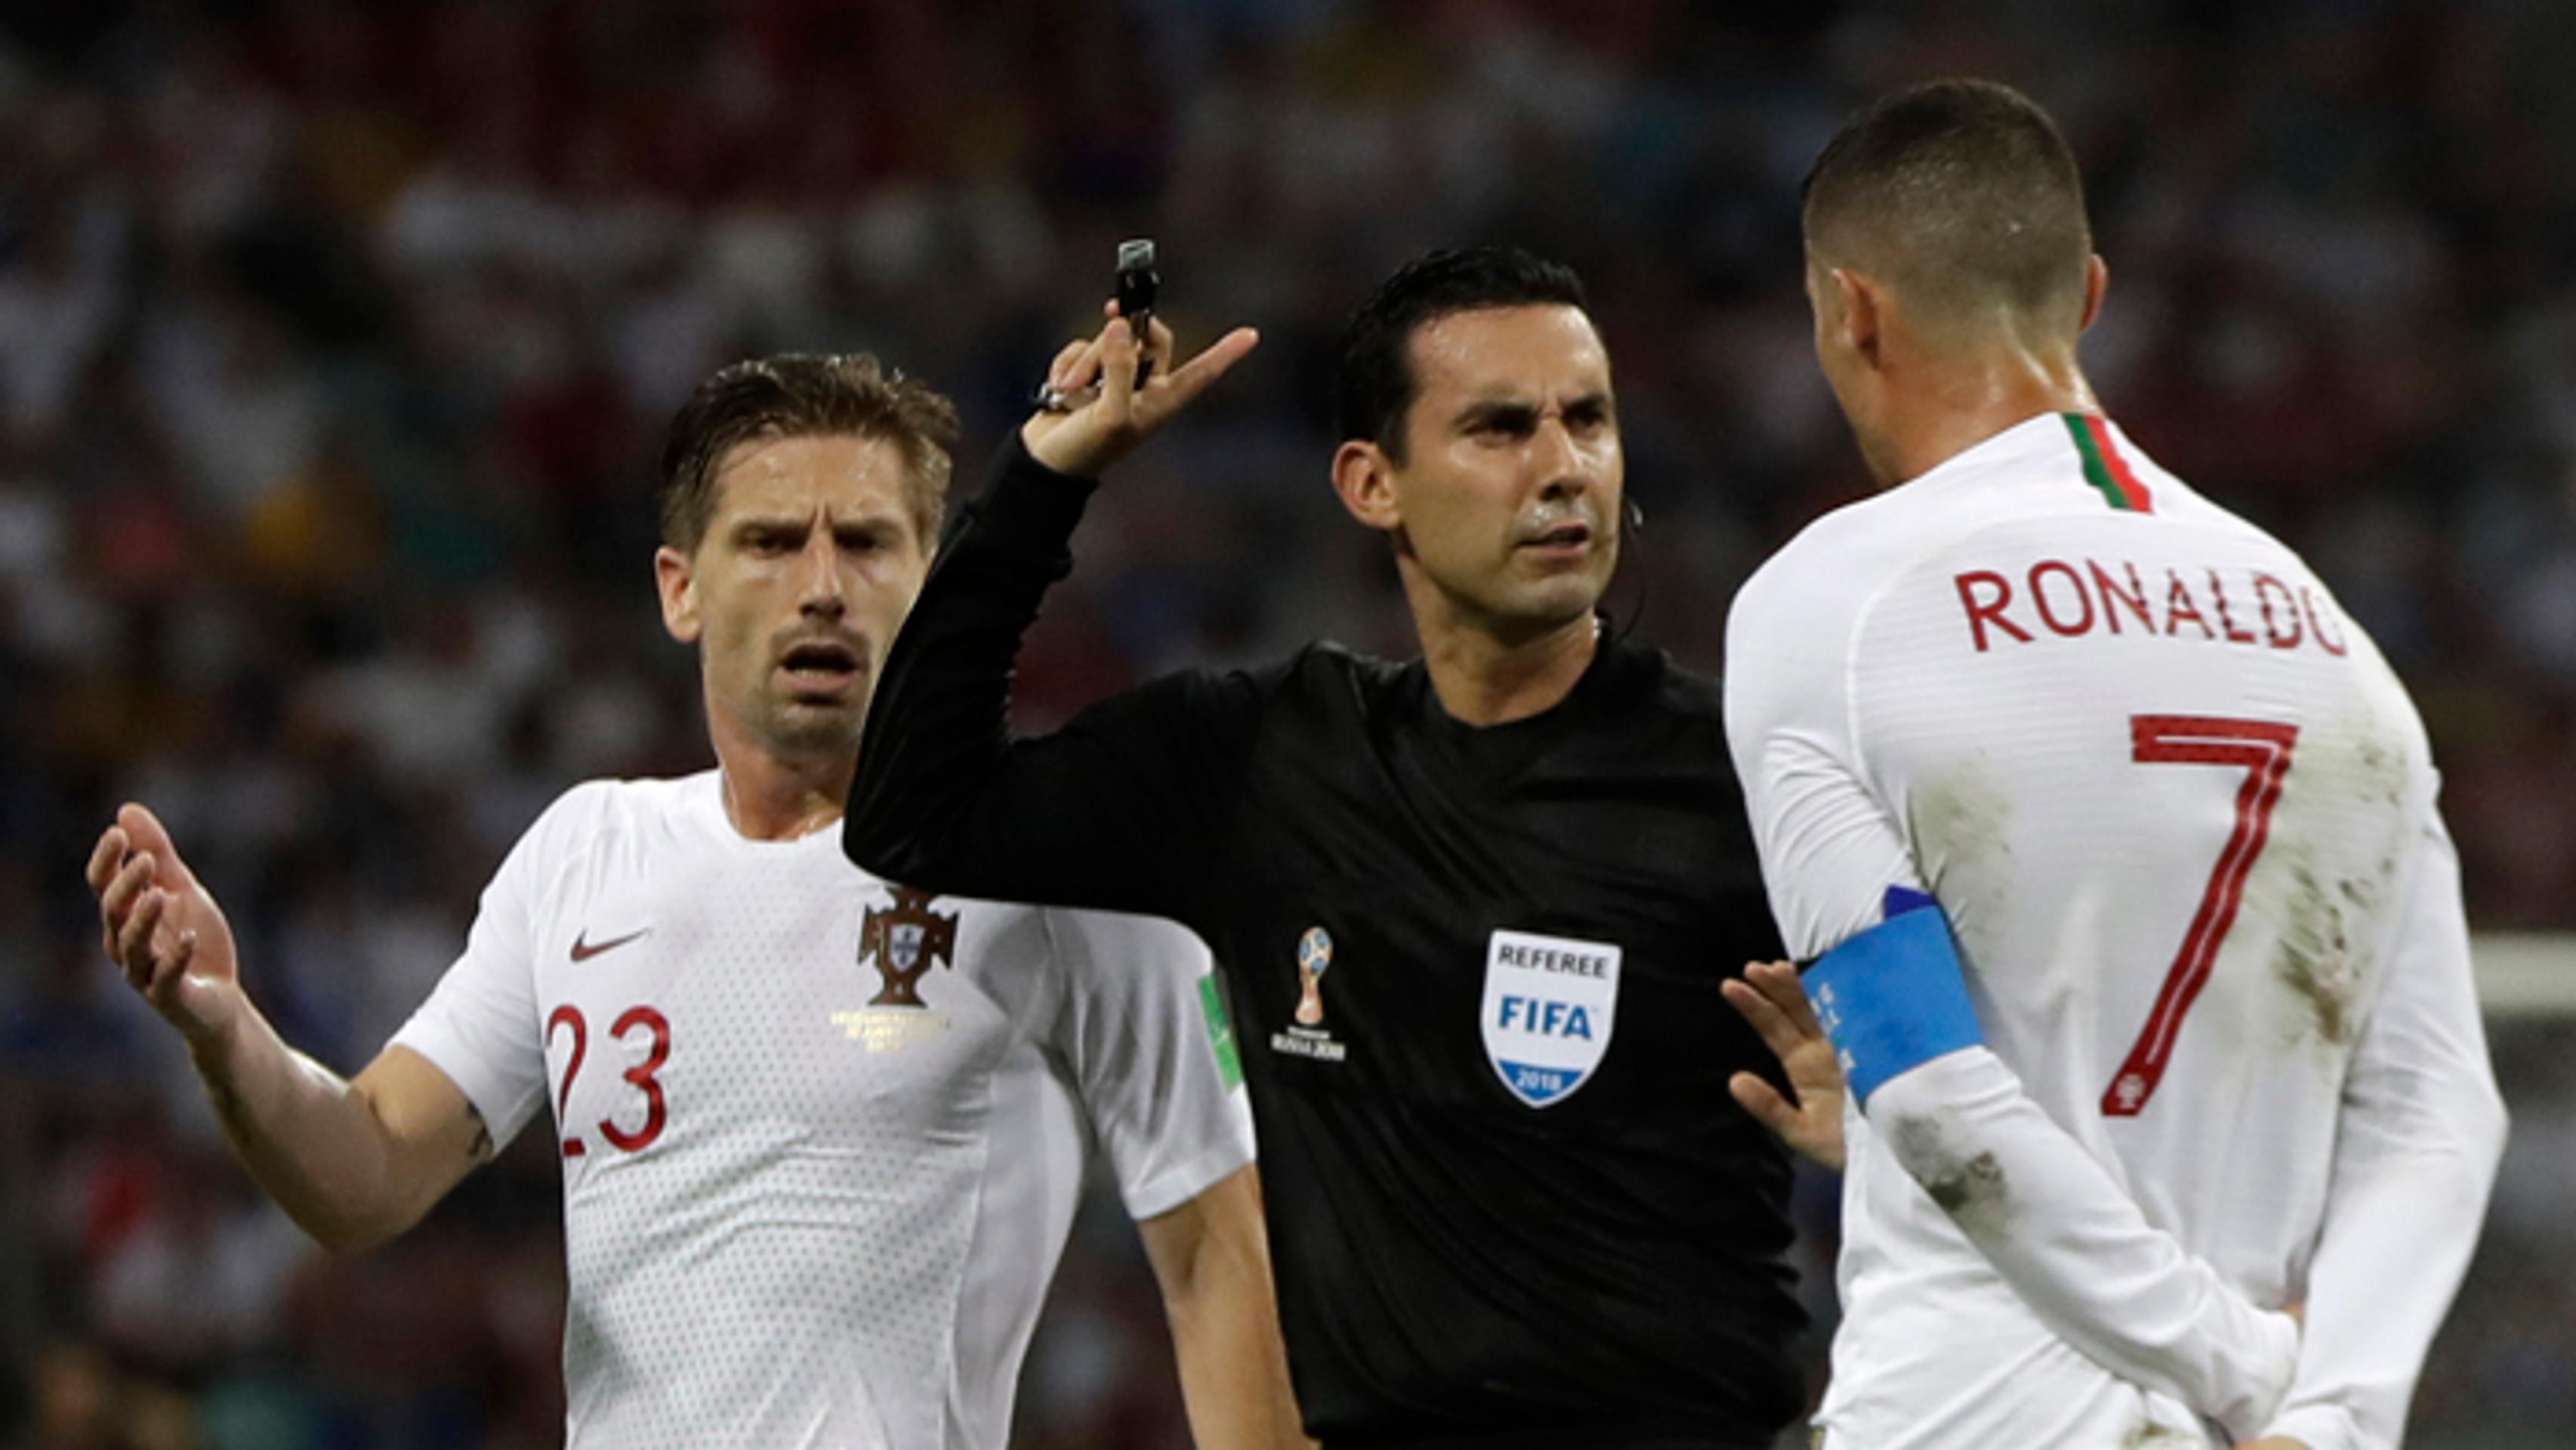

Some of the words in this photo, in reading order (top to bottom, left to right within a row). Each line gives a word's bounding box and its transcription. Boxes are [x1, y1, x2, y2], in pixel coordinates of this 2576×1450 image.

[2101, 715, 2299, 1116] 7
[1498, 944, 1609, 980] REFEREE
[1498, 995, 1592, 1039] FIFA
[546, 1004, 671, 1157] 23
[1516, 1069, 1562, 1091] 2018
